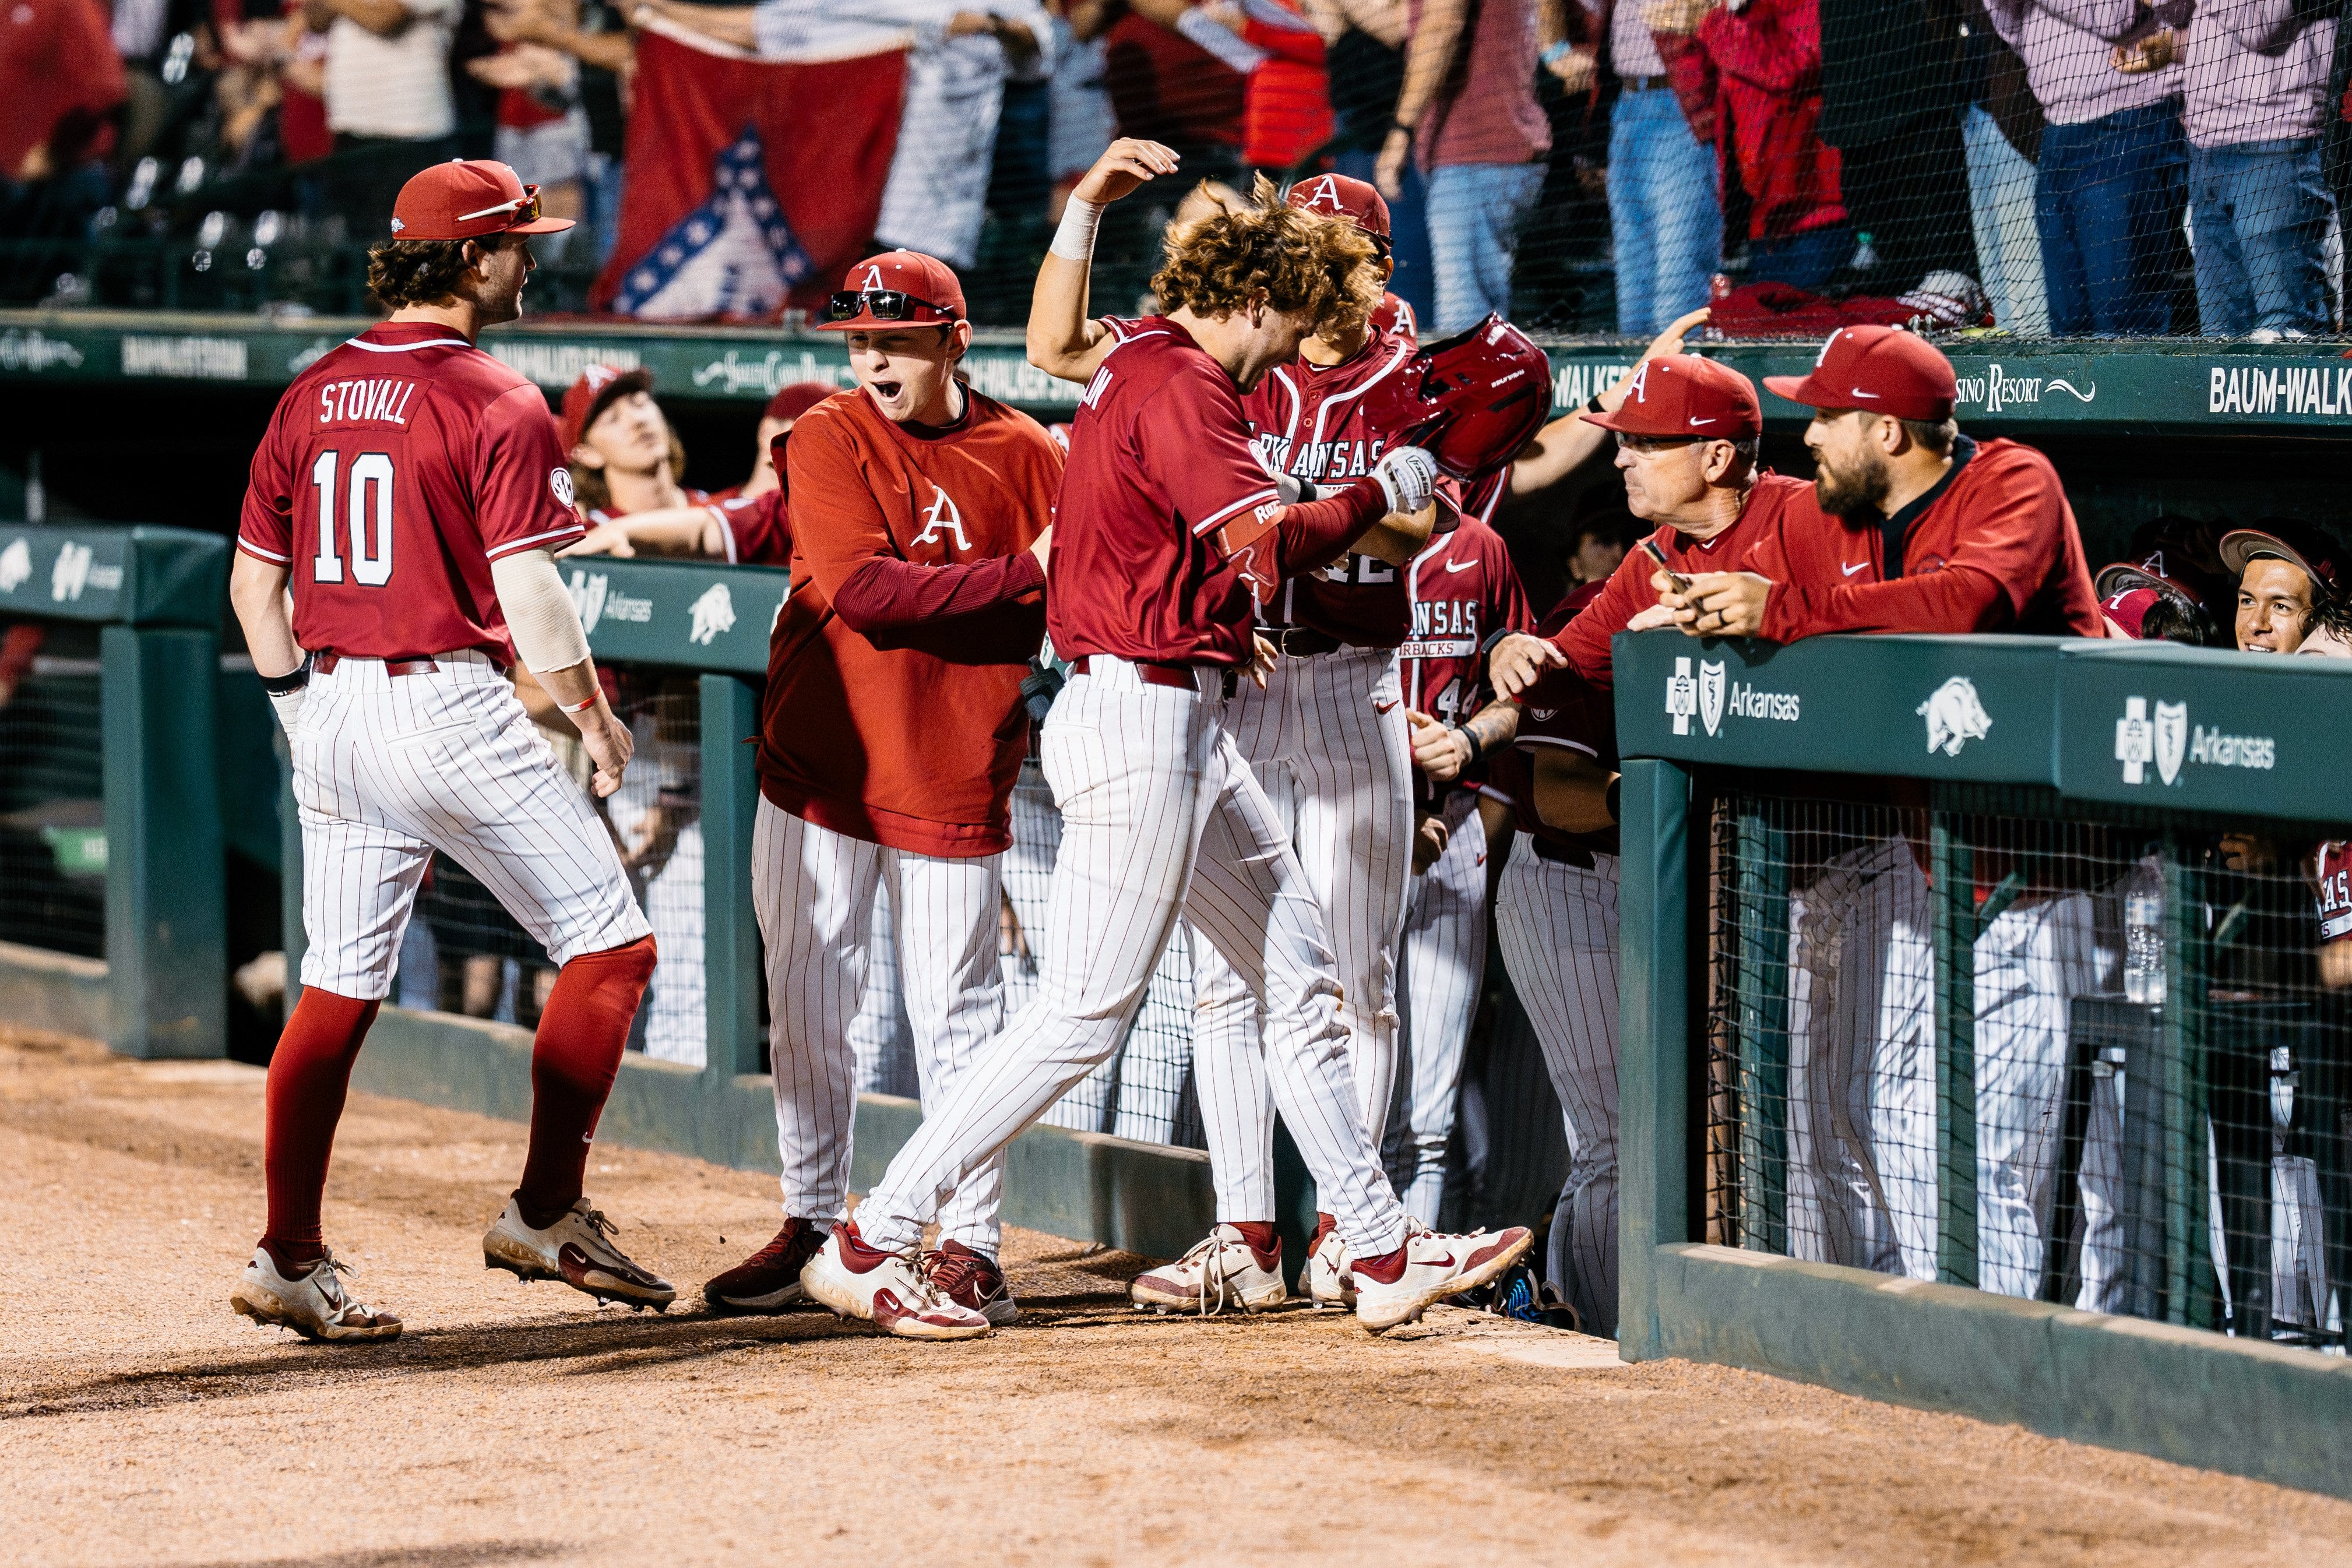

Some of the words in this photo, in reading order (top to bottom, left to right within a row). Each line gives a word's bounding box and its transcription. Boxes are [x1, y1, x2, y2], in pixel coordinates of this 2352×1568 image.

[320, 379, 415, 424] STOVALL
[312, 449, 395, 587] 10
[910, 485, 973, 551] A
[1409, 600, 1480, 636] NSAS
[1400, 643, 1455, 656] RBACKS
[1728, 681, 1800, 721] Arkansas
[2189, 724, 2276, 770] Arkansas
